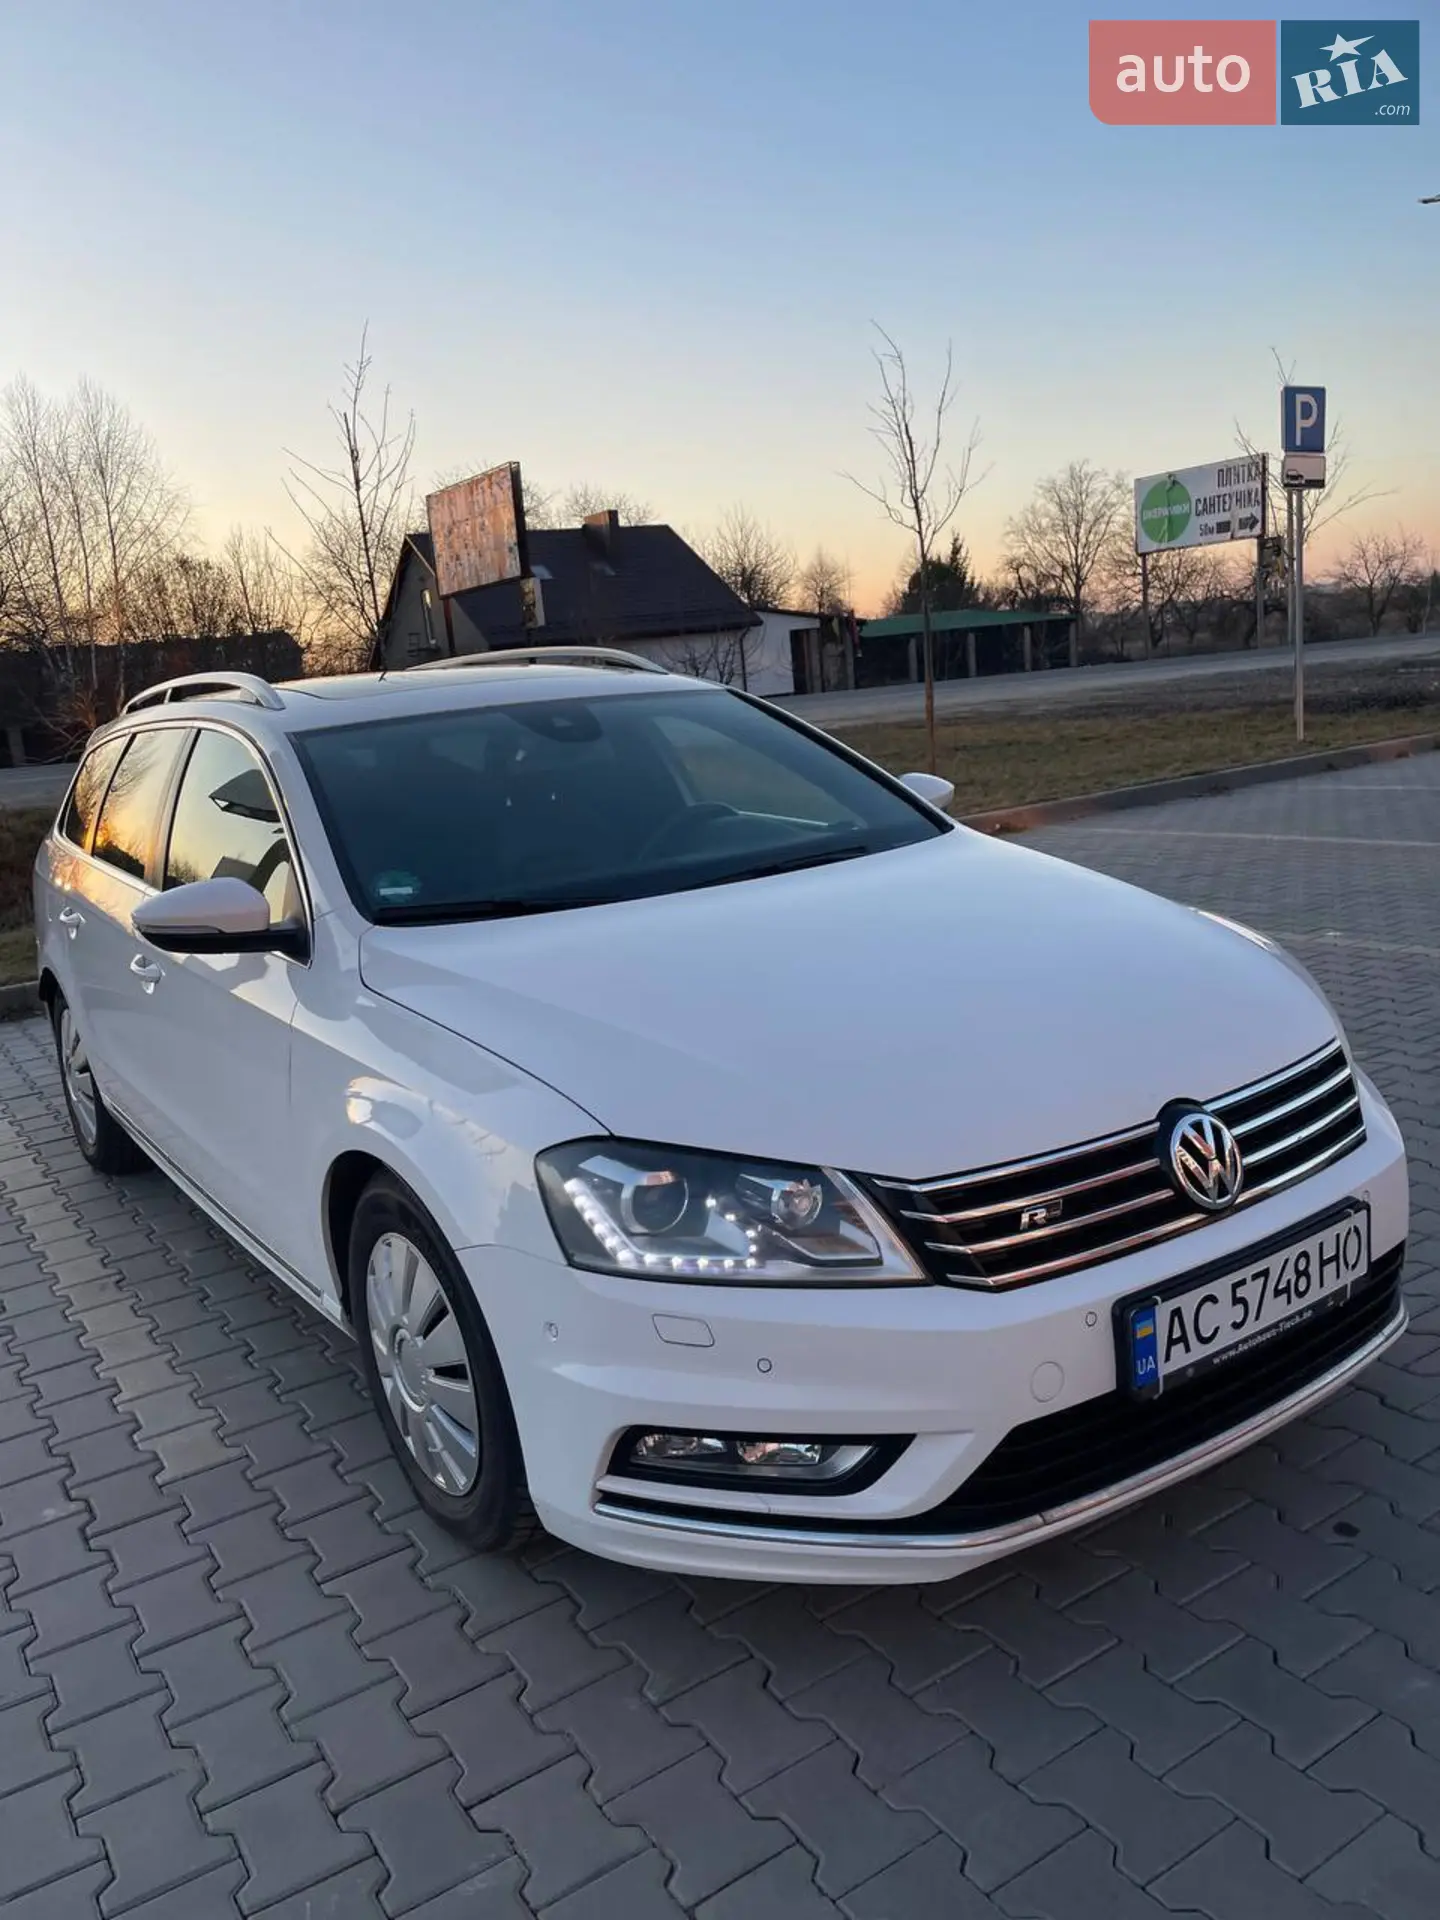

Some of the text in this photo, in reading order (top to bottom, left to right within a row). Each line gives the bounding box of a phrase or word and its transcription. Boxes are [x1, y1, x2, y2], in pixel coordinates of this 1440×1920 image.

[1295, 393, 1318, 446] P
[1164, 1225, 1362, 1363] AC 5748 HO
[1137, 1355, 1156, 1376] UA
